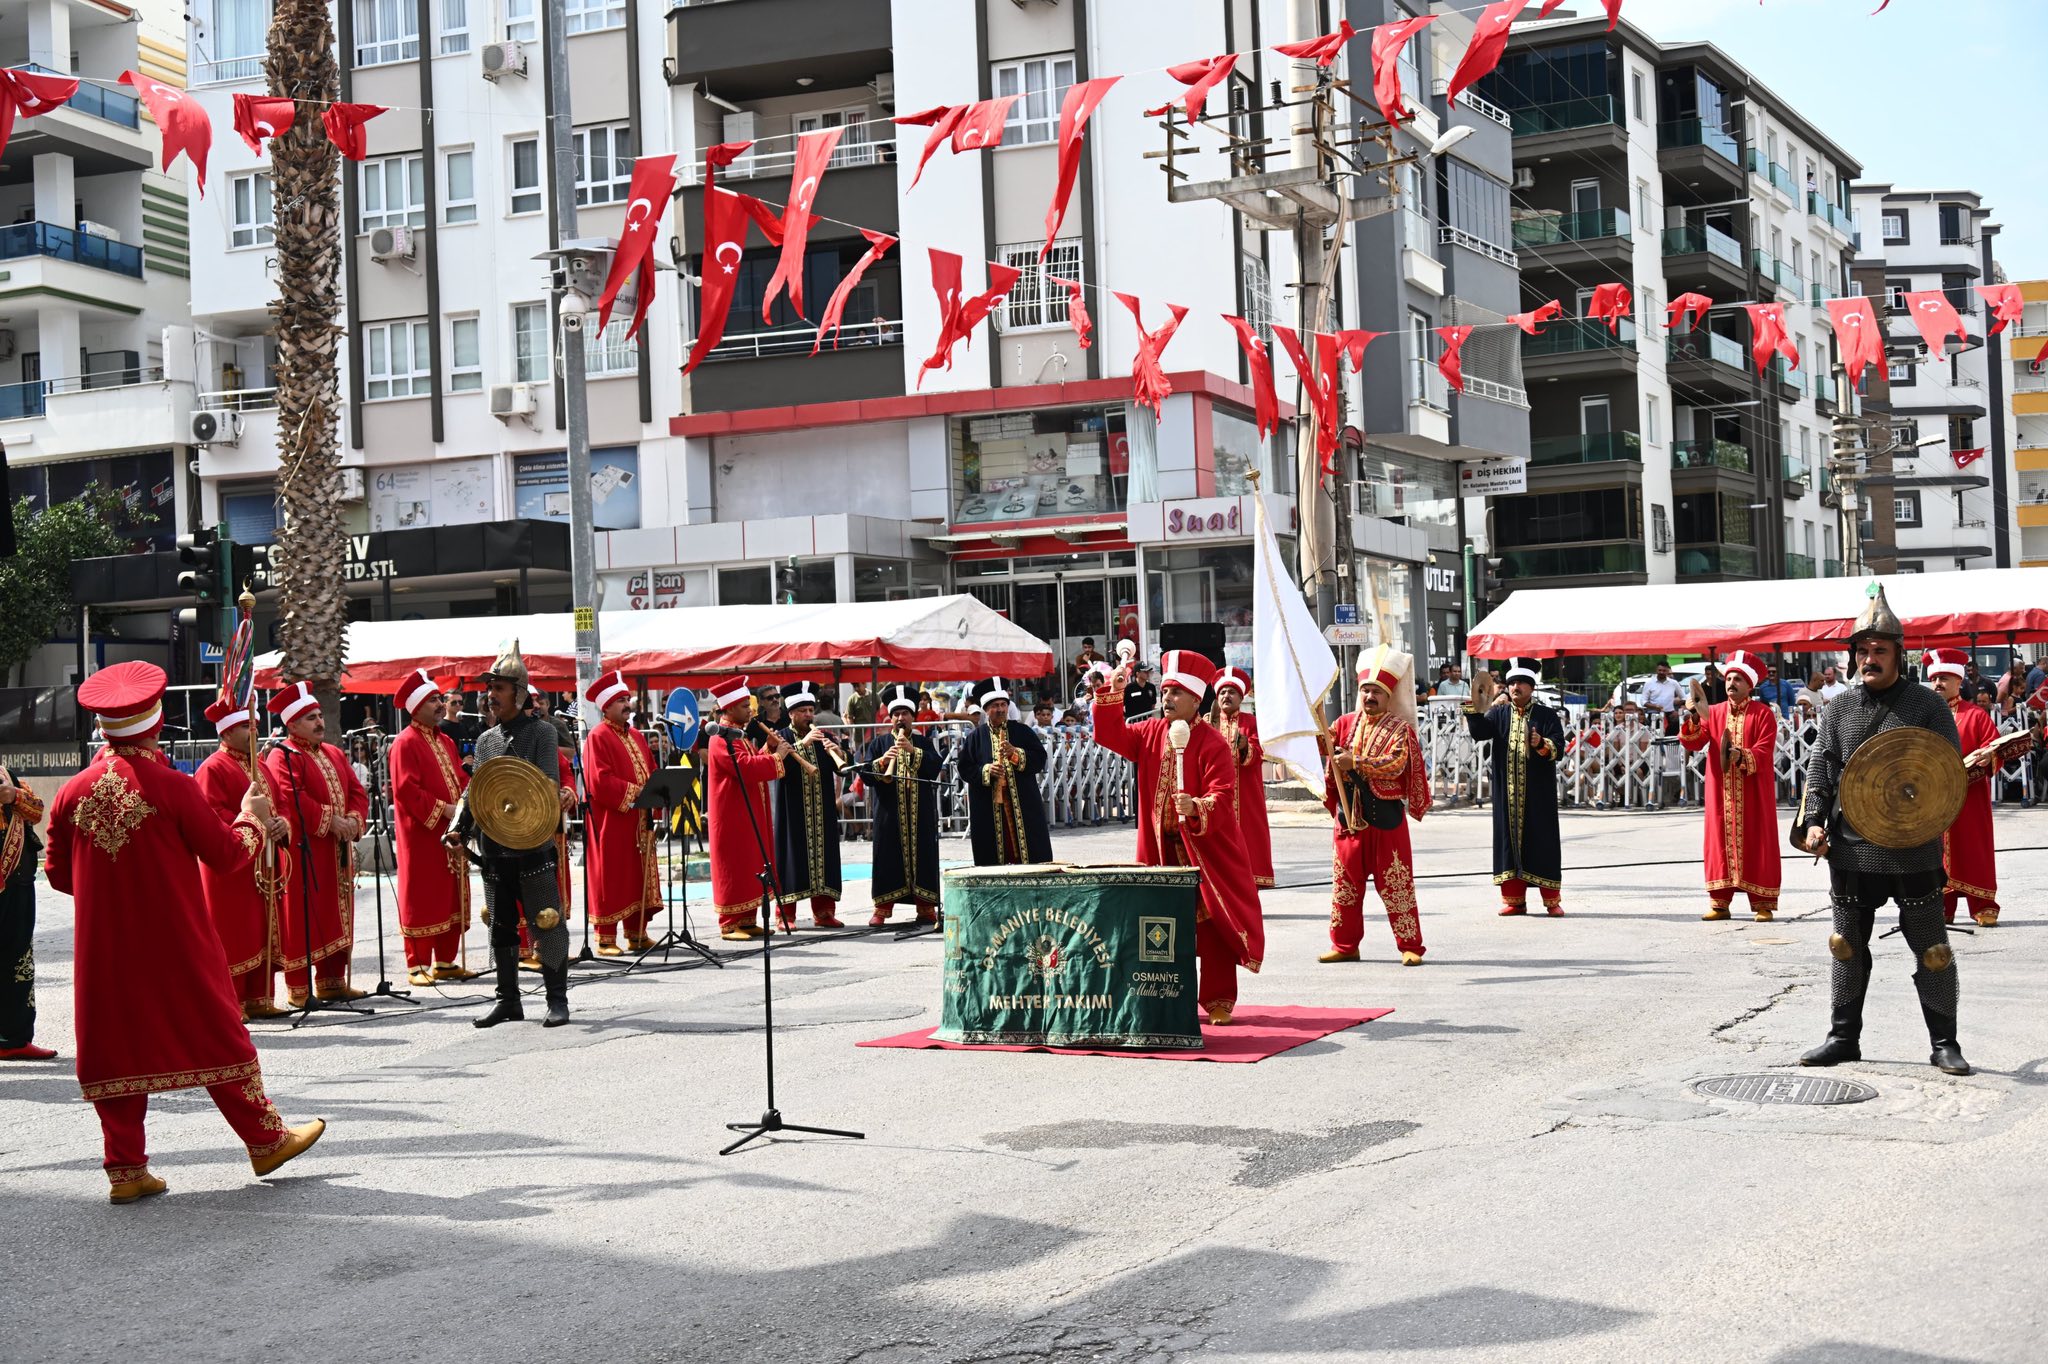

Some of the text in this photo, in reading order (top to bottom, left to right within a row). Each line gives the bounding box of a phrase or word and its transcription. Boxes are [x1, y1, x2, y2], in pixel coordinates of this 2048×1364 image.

[1477, 464, 1522, 478] DİŞ HEKİMİ
[376, 472, 395, 491] 64
[1168, 505, 1238, 533] Suat
[1, 750, 81, 772] BAHÇELİ BULVARI
[983, 907, 1115, 970] OSMANİYE BELEDİYESİ
[1132, 972, 1179, 983] OSMANİYE
[989, 994, 1112, 1010] MEHTER TAKIMI
